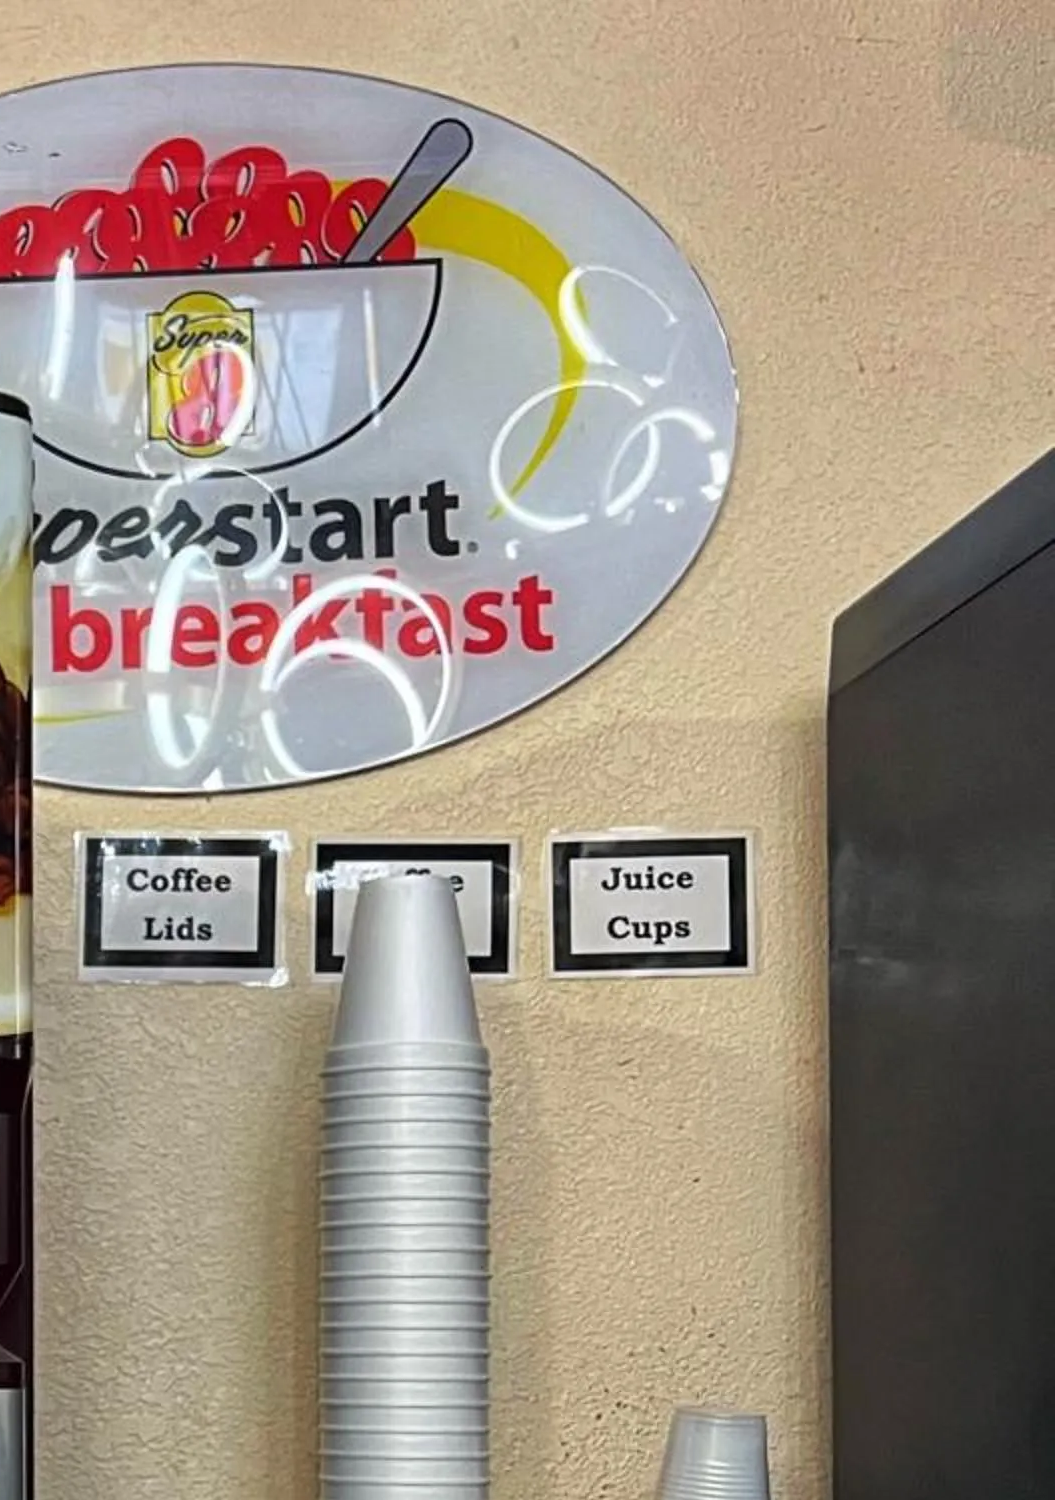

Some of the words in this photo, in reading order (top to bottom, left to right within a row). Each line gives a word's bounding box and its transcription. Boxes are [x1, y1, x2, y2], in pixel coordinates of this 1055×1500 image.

[153, 314, 249, 367] Super
[50, 568, 554, 674] breakfast
[126, 868, 232, 892] Coffee
[600, 866, 694, 891] Juice
[143, 917, 213, 941] Lids
[607, 916, 692, 945] Cups
